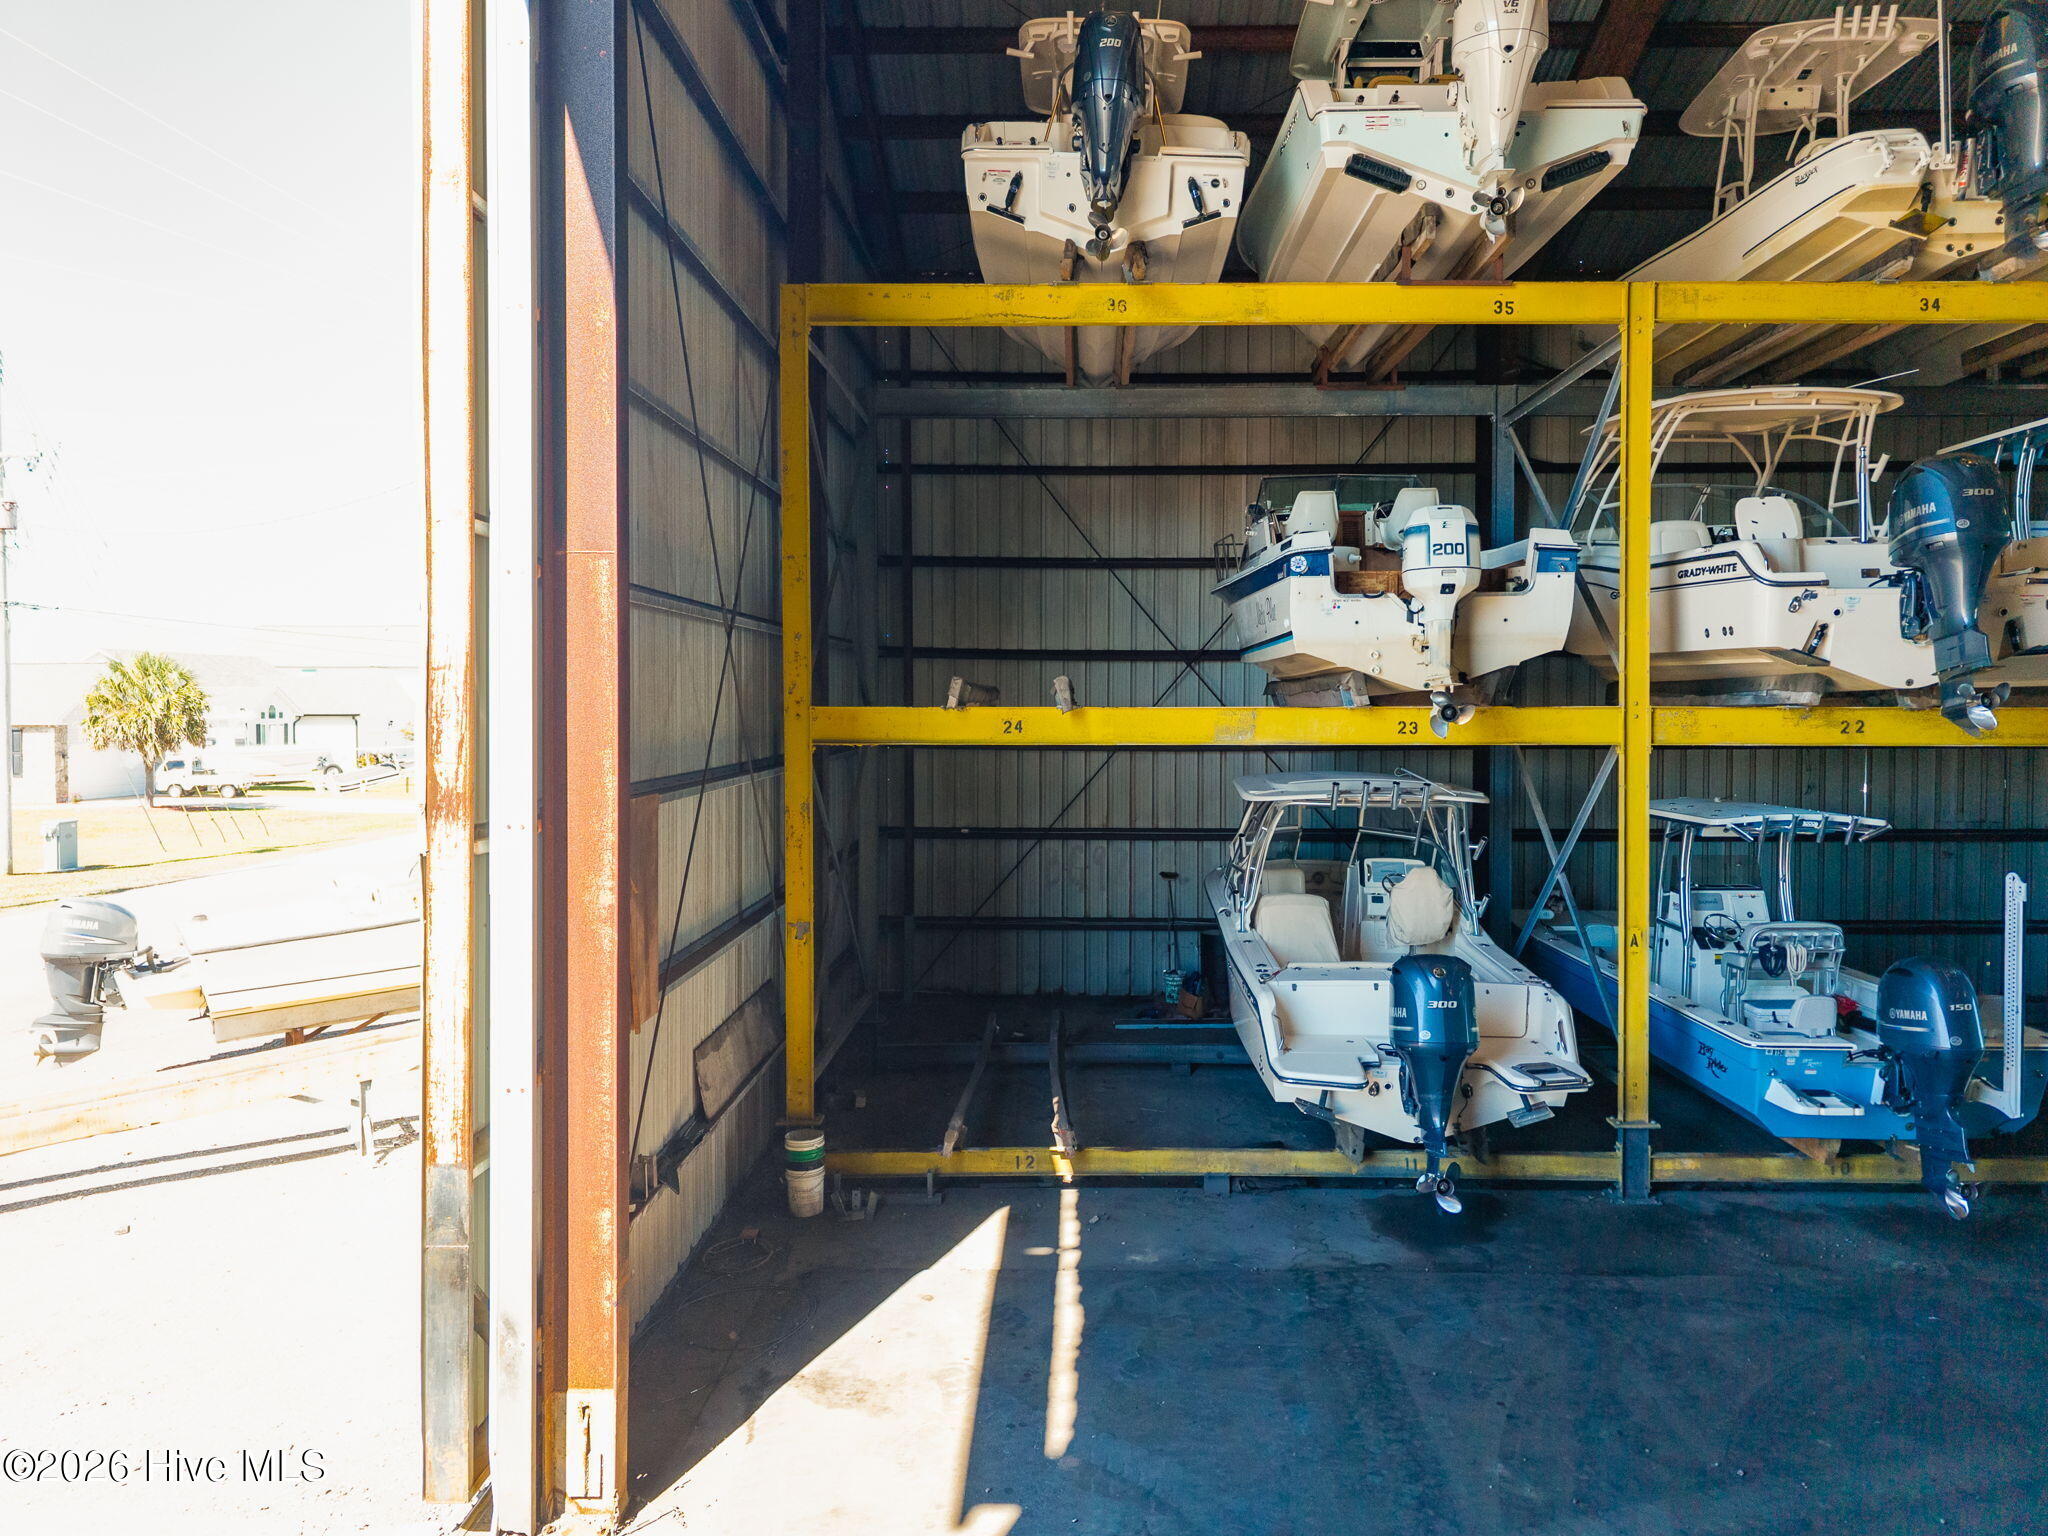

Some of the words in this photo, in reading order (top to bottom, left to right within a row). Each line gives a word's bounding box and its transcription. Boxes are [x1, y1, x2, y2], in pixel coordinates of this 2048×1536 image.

[1100, 37, 1122, 48] 200
[1107, 298, 1127, 313] 36
[1493, 300, 1515, 315] 35
[1919, 297, 1941, 312] 34
[1962, 488, 1995, 496] 300
[1904, 502, 1937, 520] YAMAHA
[1432, 542, 1465, 556] 200
[1677, 562, 1738, 579] GRADY-WHITE
[1003, 719, 1023, 734] 24
[1397, 720, 1418, 735] 23
[1840, 719, 1865, 735] 22
[1630, 933, 1639, 948] A
[1426, 1000, 1458, 1009] 300
[1949, 1003, 1973, 1012] 150
[1896, 1008, 1928, 1021] YAMAHA
[1015, 1154, 1035, 1170] 12
[1405, 1157, 1418, 1171] 11
